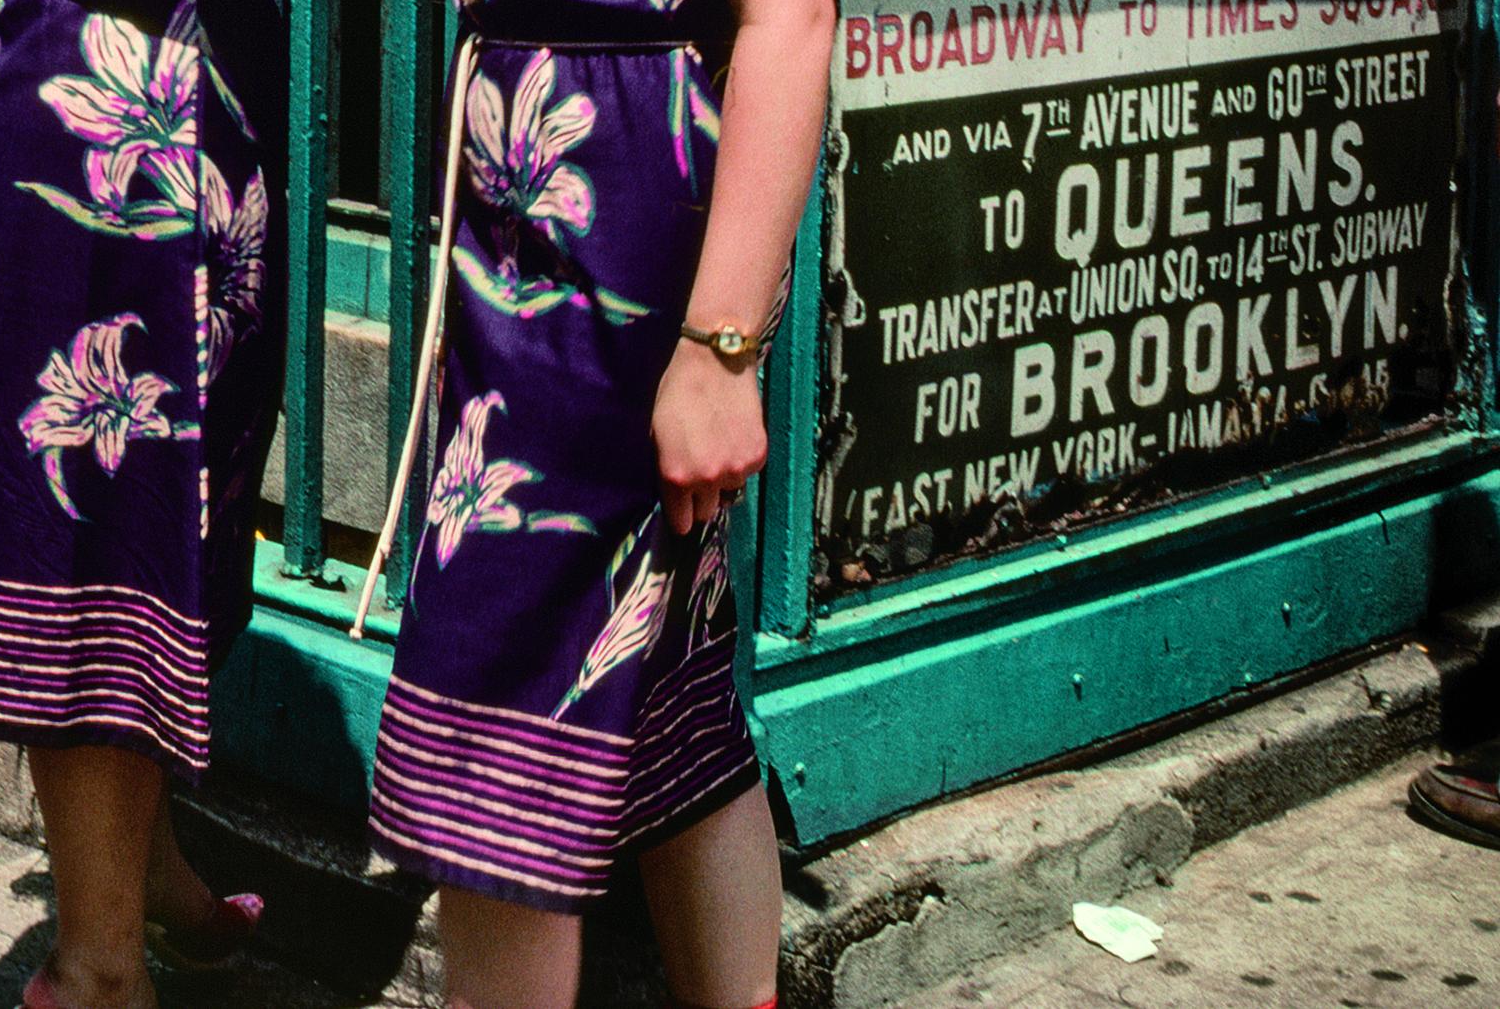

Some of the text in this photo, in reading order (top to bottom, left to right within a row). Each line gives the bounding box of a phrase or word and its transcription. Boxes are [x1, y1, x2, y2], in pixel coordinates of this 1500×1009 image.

[891, 128, 951, 165] AND
[962, 120, 1013, 154] VIA
[1079, 80, 1200, 151] AVENUE
[1210, 84, 1257, 118] AND
[1333, 48, 1431, 110] STREET
[979, 119, 1377, 269] TO QUEENS.
[878, 279, 1035, 366] TRANSFER
[1035, 286, 1068, 319] AT
[1069, 254, 1157, 326] UNION
[1159, 244, 1205, 305] SQ.
[1206, 251, 1233, 282] TO
[1289, 222, 1324, 277] ST.
[1330, 200, 1429, 269] SUBWAY
[913, 372, 982, 445] FOR
[1009, 265, 1409, 439] BROOKLYN.
[963, 445, 1042, 517] NEW
